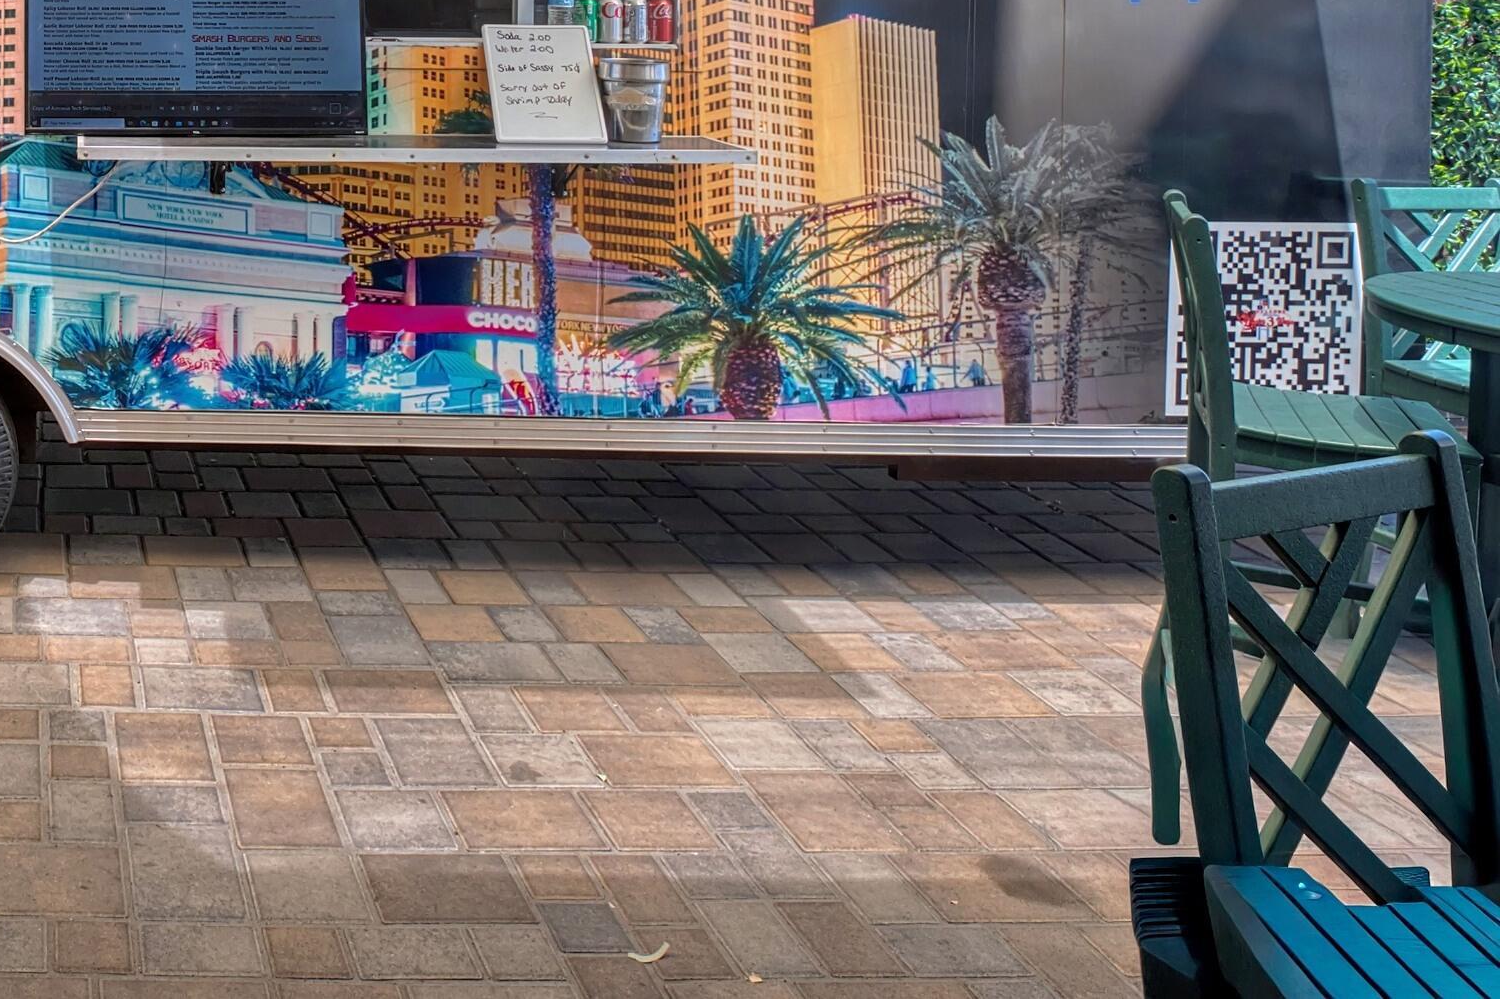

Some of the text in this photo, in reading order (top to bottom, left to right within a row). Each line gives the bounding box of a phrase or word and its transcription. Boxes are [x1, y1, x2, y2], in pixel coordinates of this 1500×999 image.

[191, 34, 223, 43] SMASH
[273, 35, 292, 43] AND
[496, 30, 522, 41] Soda
[497, 64, 515, 73] Side
[500, 83, 527, 93] Sorry
[147, 203, 163, 211] NEW
[187, 208, 202, 216] NEW
[467, 310, 537, 333] CHOCO
